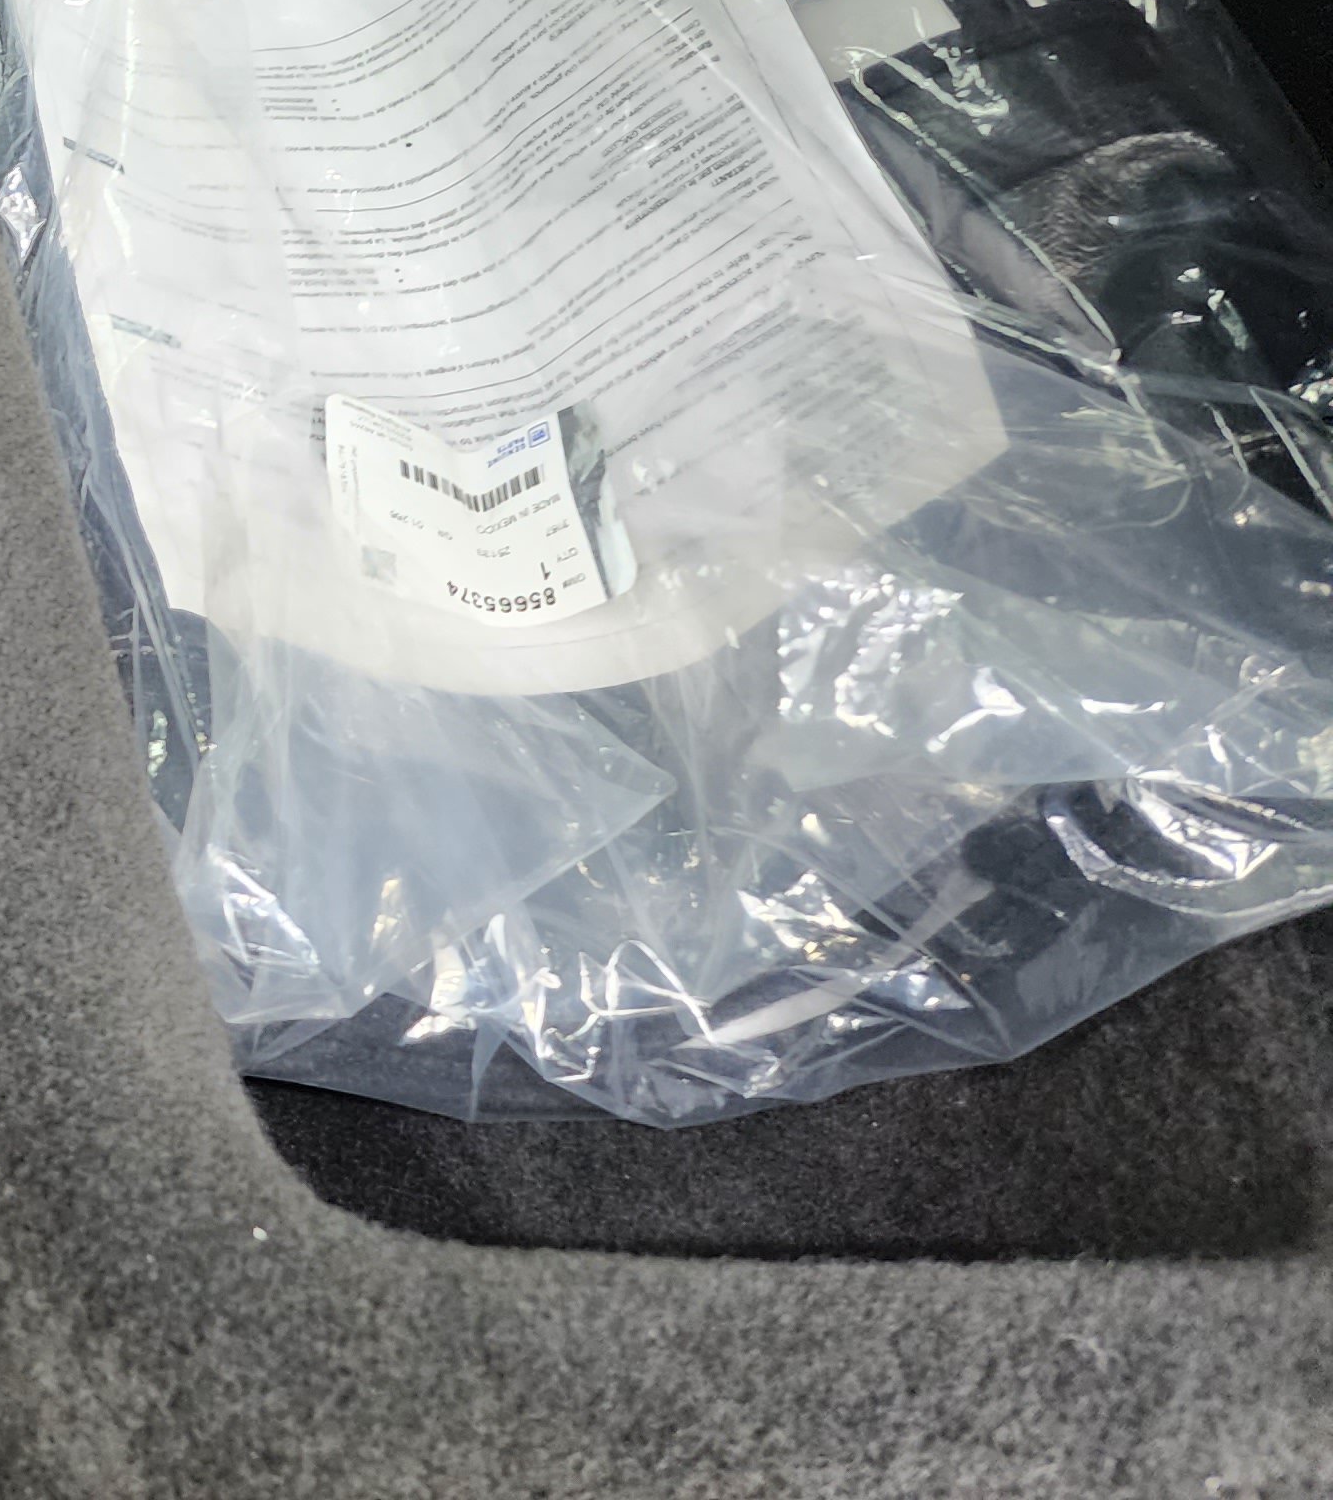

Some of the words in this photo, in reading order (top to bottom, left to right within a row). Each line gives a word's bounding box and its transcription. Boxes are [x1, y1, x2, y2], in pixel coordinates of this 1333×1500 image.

[476, 515, 518, 535] MEXICO
[556, 547, 579, 563] QTY
[540, 561, 551, 581] 1
[446, 580, 556, 614] 85665374
